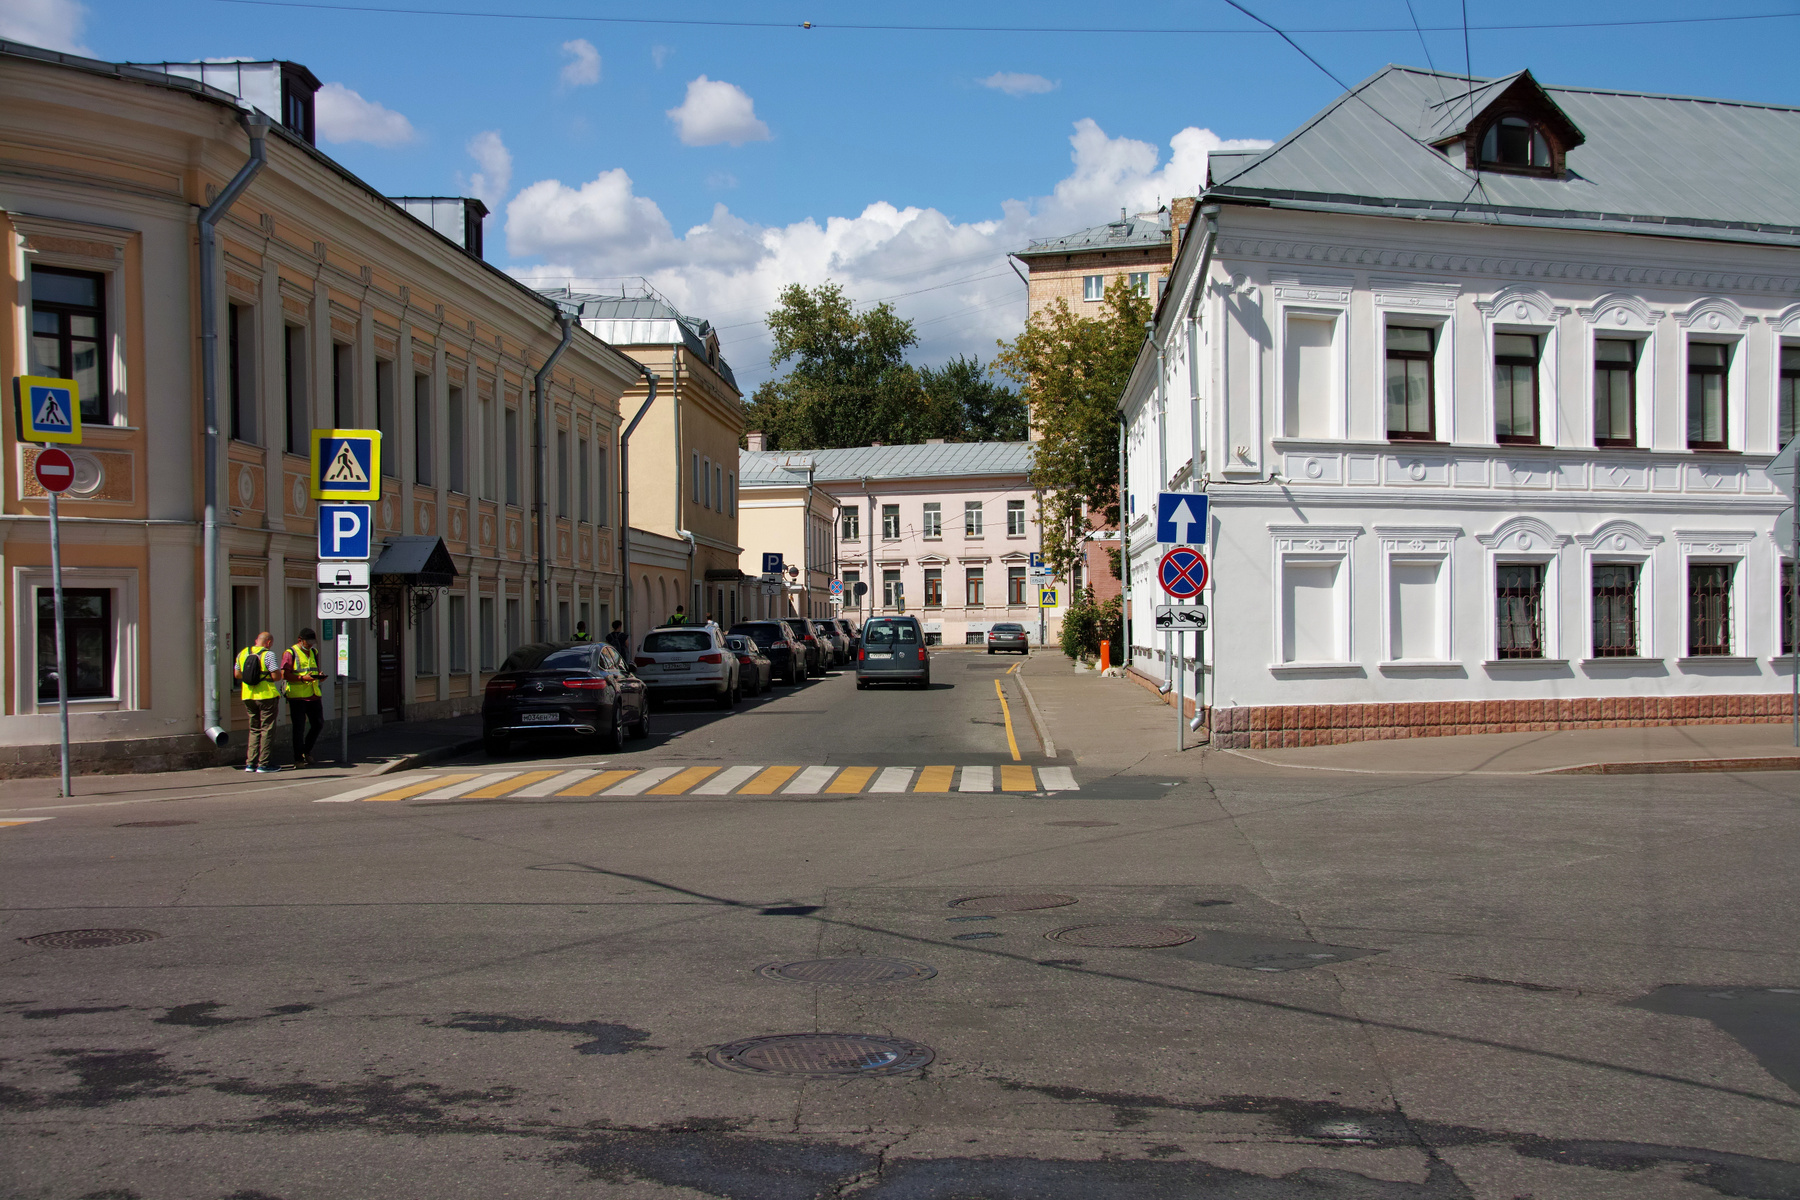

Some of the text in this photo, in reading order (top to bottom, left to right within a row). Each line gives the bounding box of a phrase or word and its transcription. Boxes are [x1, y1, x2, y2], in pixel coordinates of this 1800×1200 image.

[333, 511, 361, 552] P
[768, 555, 779, 571] P
[335, 601, 344, 610] 15
[348, 600, 363, 611] 20
